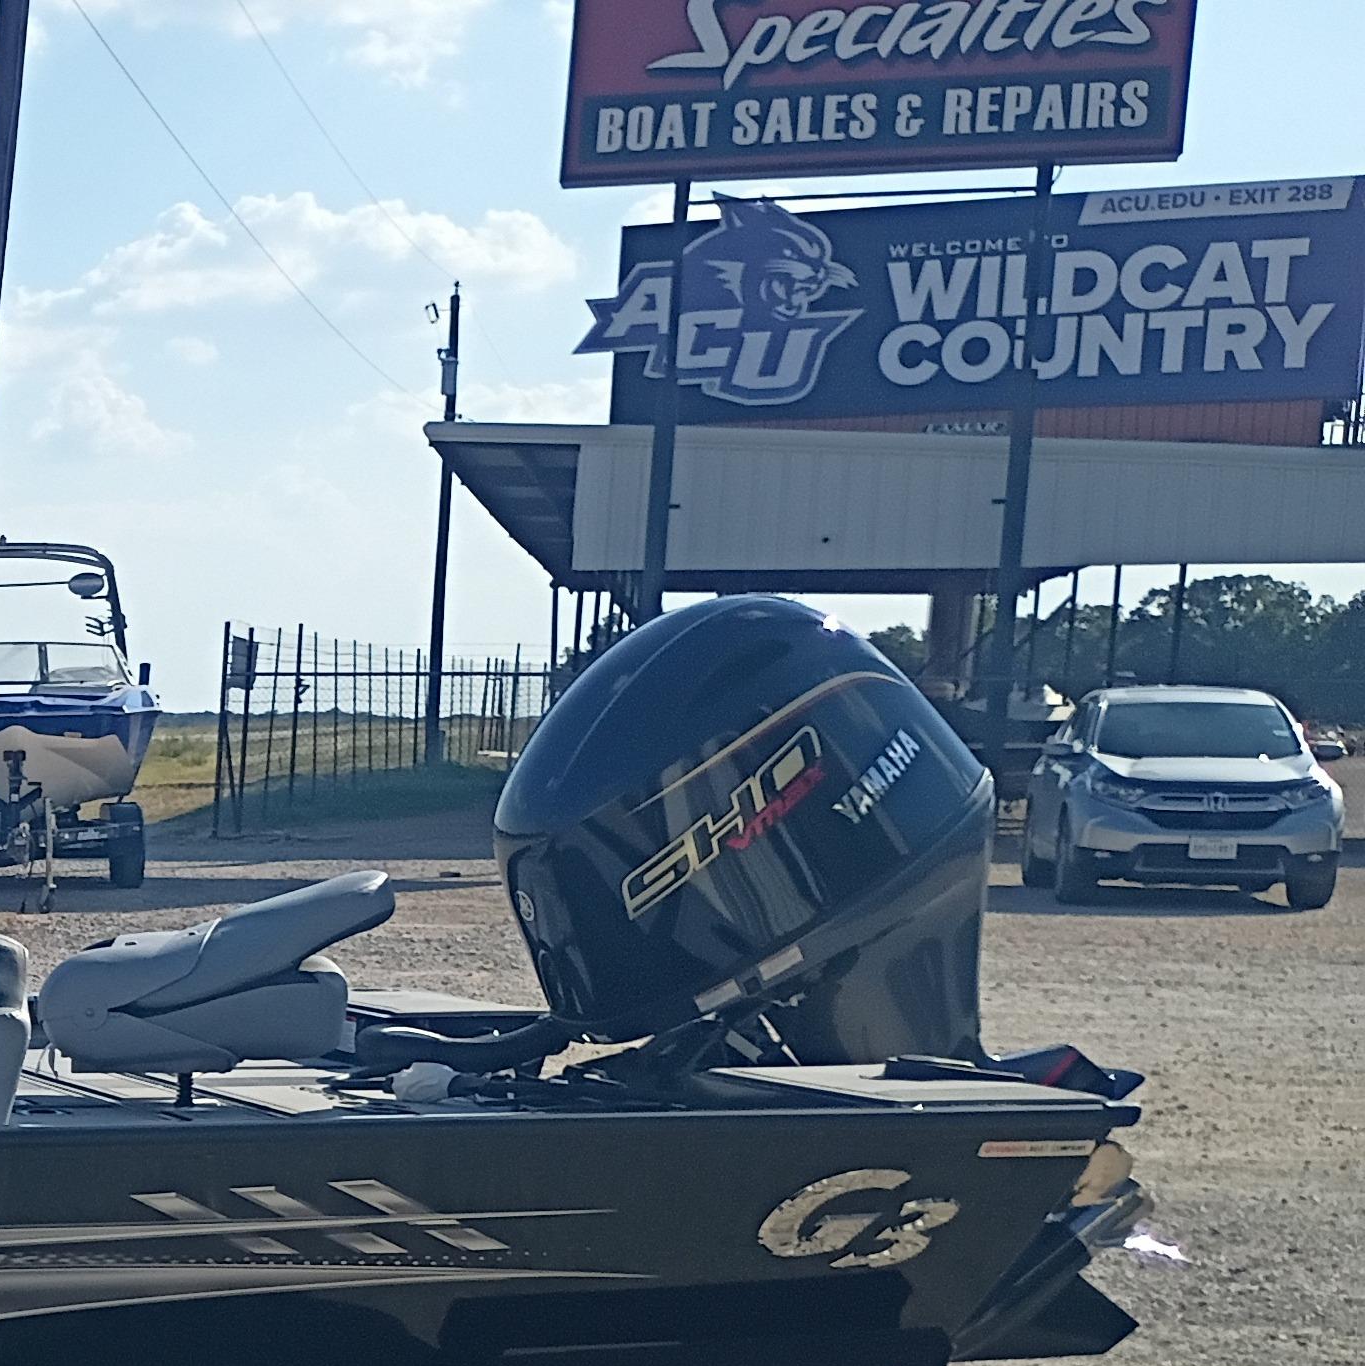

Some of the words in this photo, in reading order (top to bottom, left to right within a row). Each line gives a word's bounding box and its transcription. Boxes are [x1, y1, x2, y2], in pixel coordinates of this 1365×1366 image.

[646, 0, 1167, 90] Specialties
[595, 102, 717, 154] BOAT
[732, 93, 877, 146] SALES
[894, 94, 925, 138] &
[942, 80, 1150, 135] REPAIRS
[1100, 190, 1206, 214] ACU.EDU
[1228, 186, 1281, 208] EXIT
[1287, 183, 1334, 203] 288
[886, 237, 1311, 323] WILDCAT
[888, 237, 1022, 258] WELCOME
[1028, 230, 1070, 250] O
[602, 276, 821, 390] ACU
[878, 303, 1336, 386] COUNTRY
[830, 728, 922, 825] YAMAHA
[757, 1167, 961, 1269] G3
